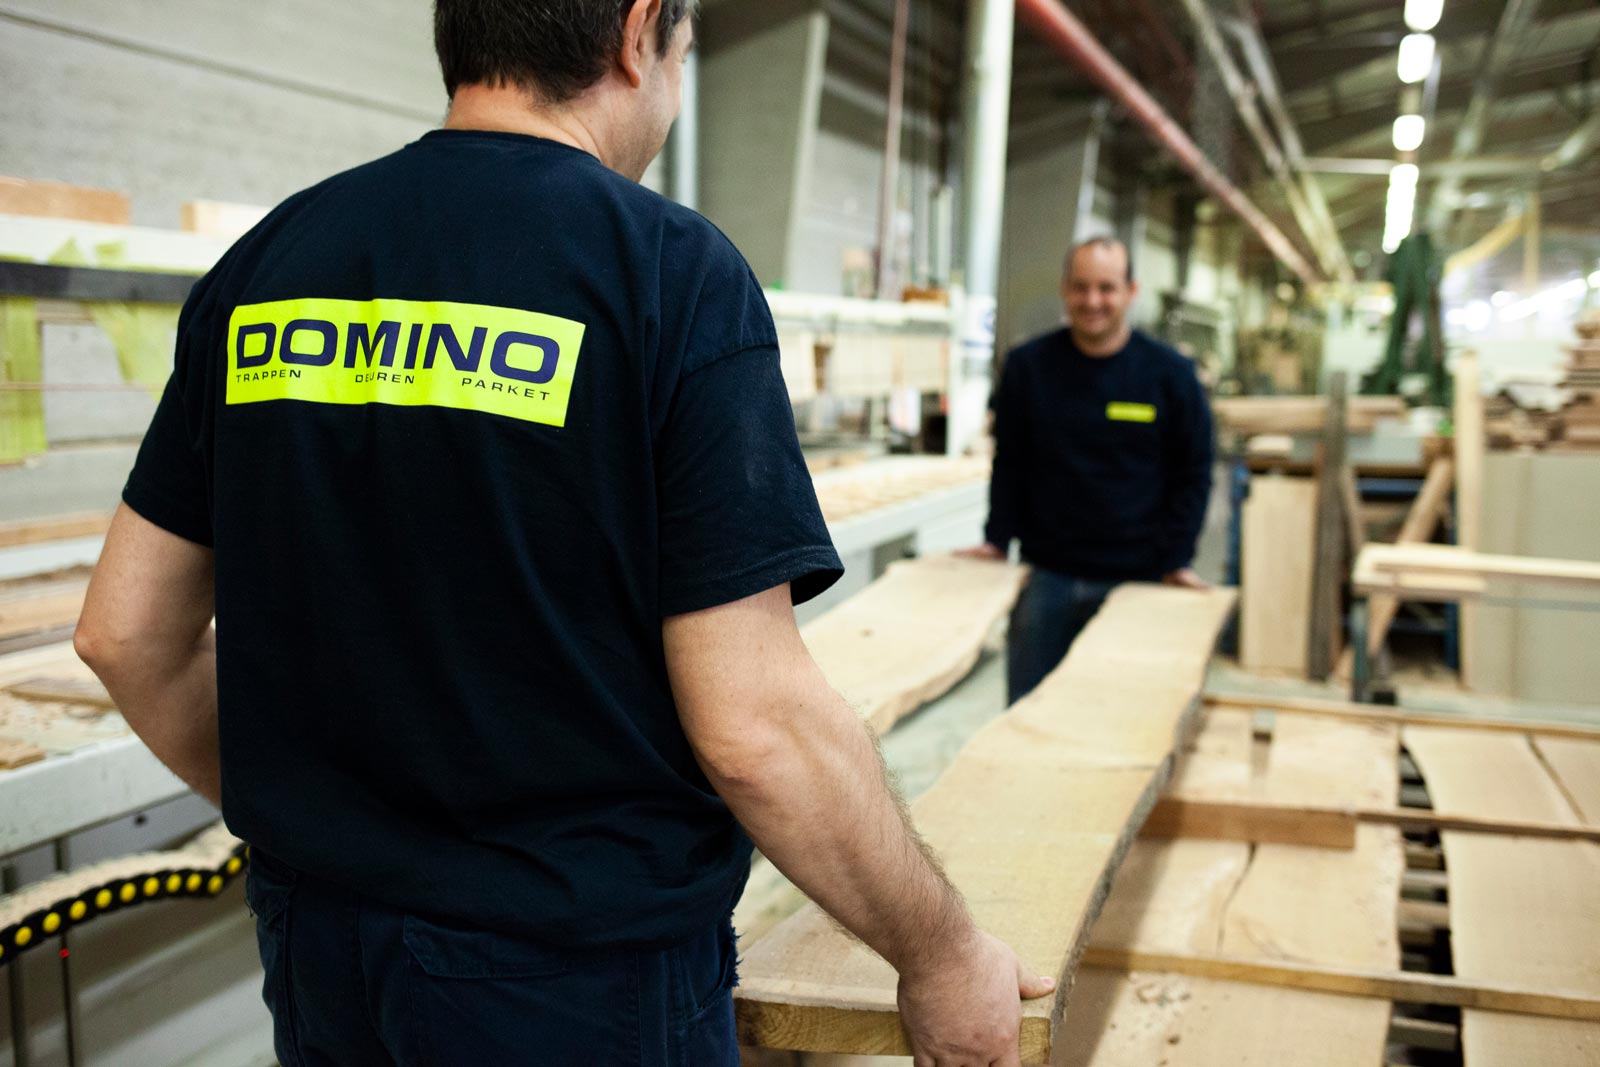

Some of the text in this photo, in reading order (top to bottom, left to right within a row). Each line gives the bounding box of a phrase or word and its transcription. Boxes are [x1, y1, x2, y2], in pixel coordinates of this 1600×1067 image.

[236, 319, 560, 384] DOMINO
[236, 369, 550, 401] TRAPPEN DEUREN PARKET
